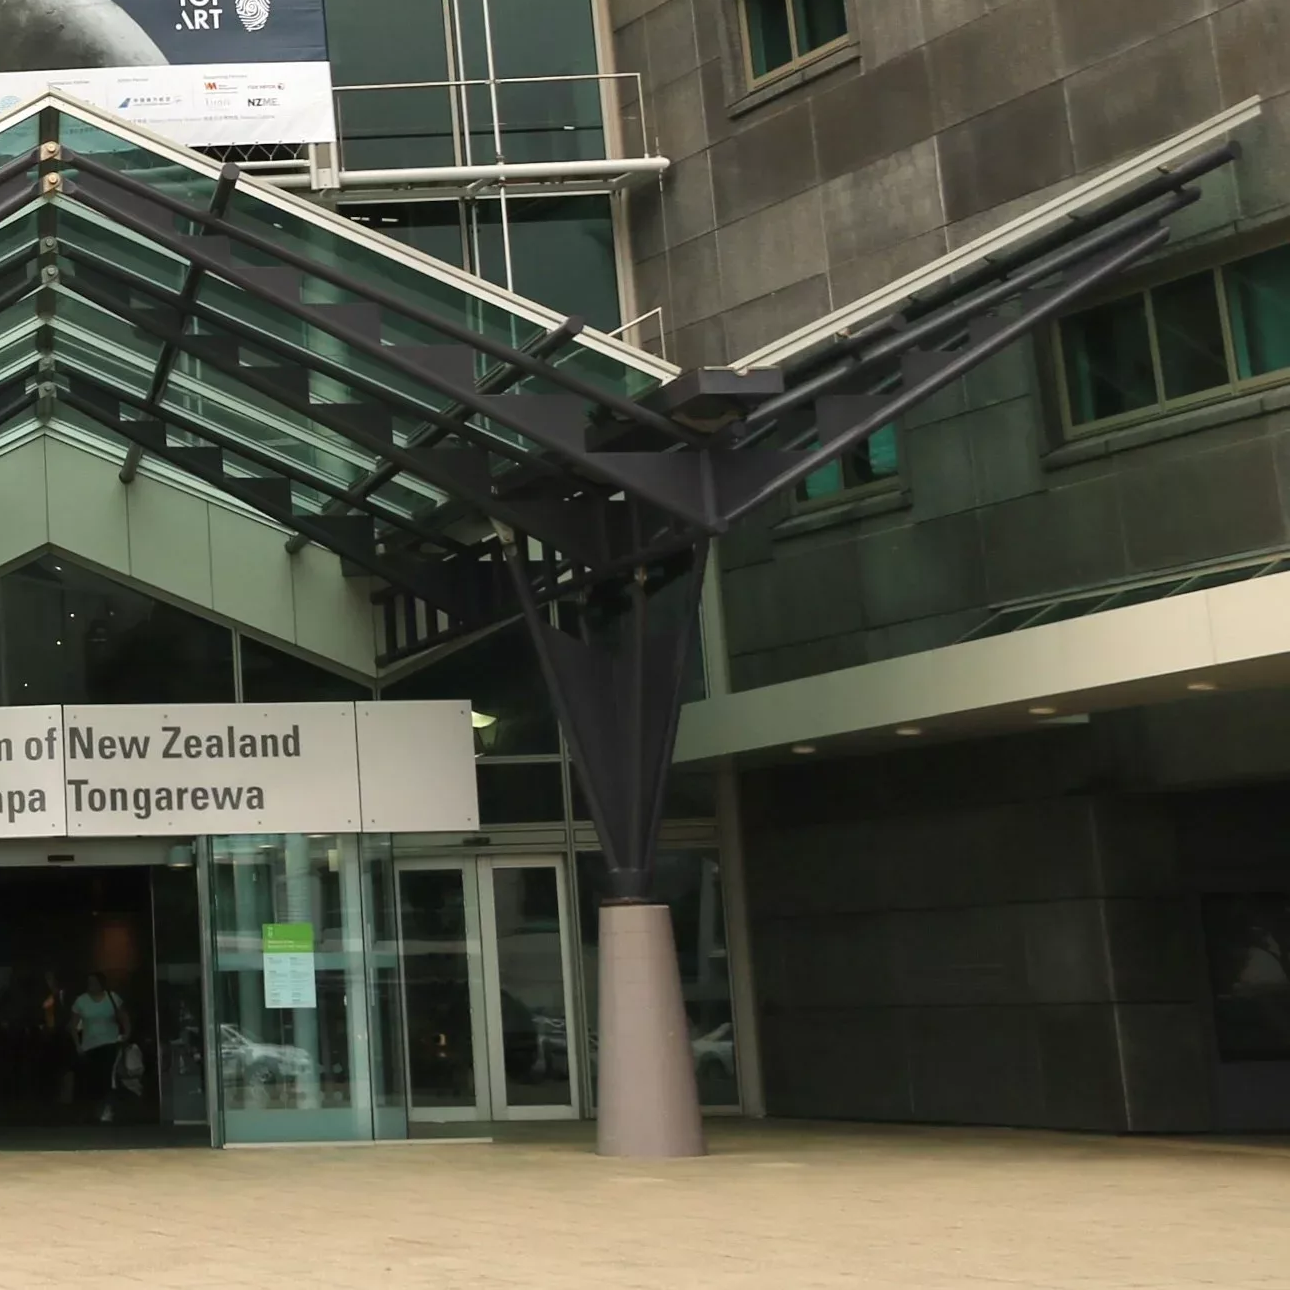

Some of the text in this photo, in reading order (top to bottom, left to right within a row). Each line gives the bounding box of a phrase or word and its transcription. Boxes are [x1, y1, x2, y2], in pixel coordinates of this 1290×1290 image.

[24, 727, 57, 761] of
[68, 726, 150, 760] New
[161, 724, 301, 759] Zealand
[67, 778, 265, 820] Tongarewa
